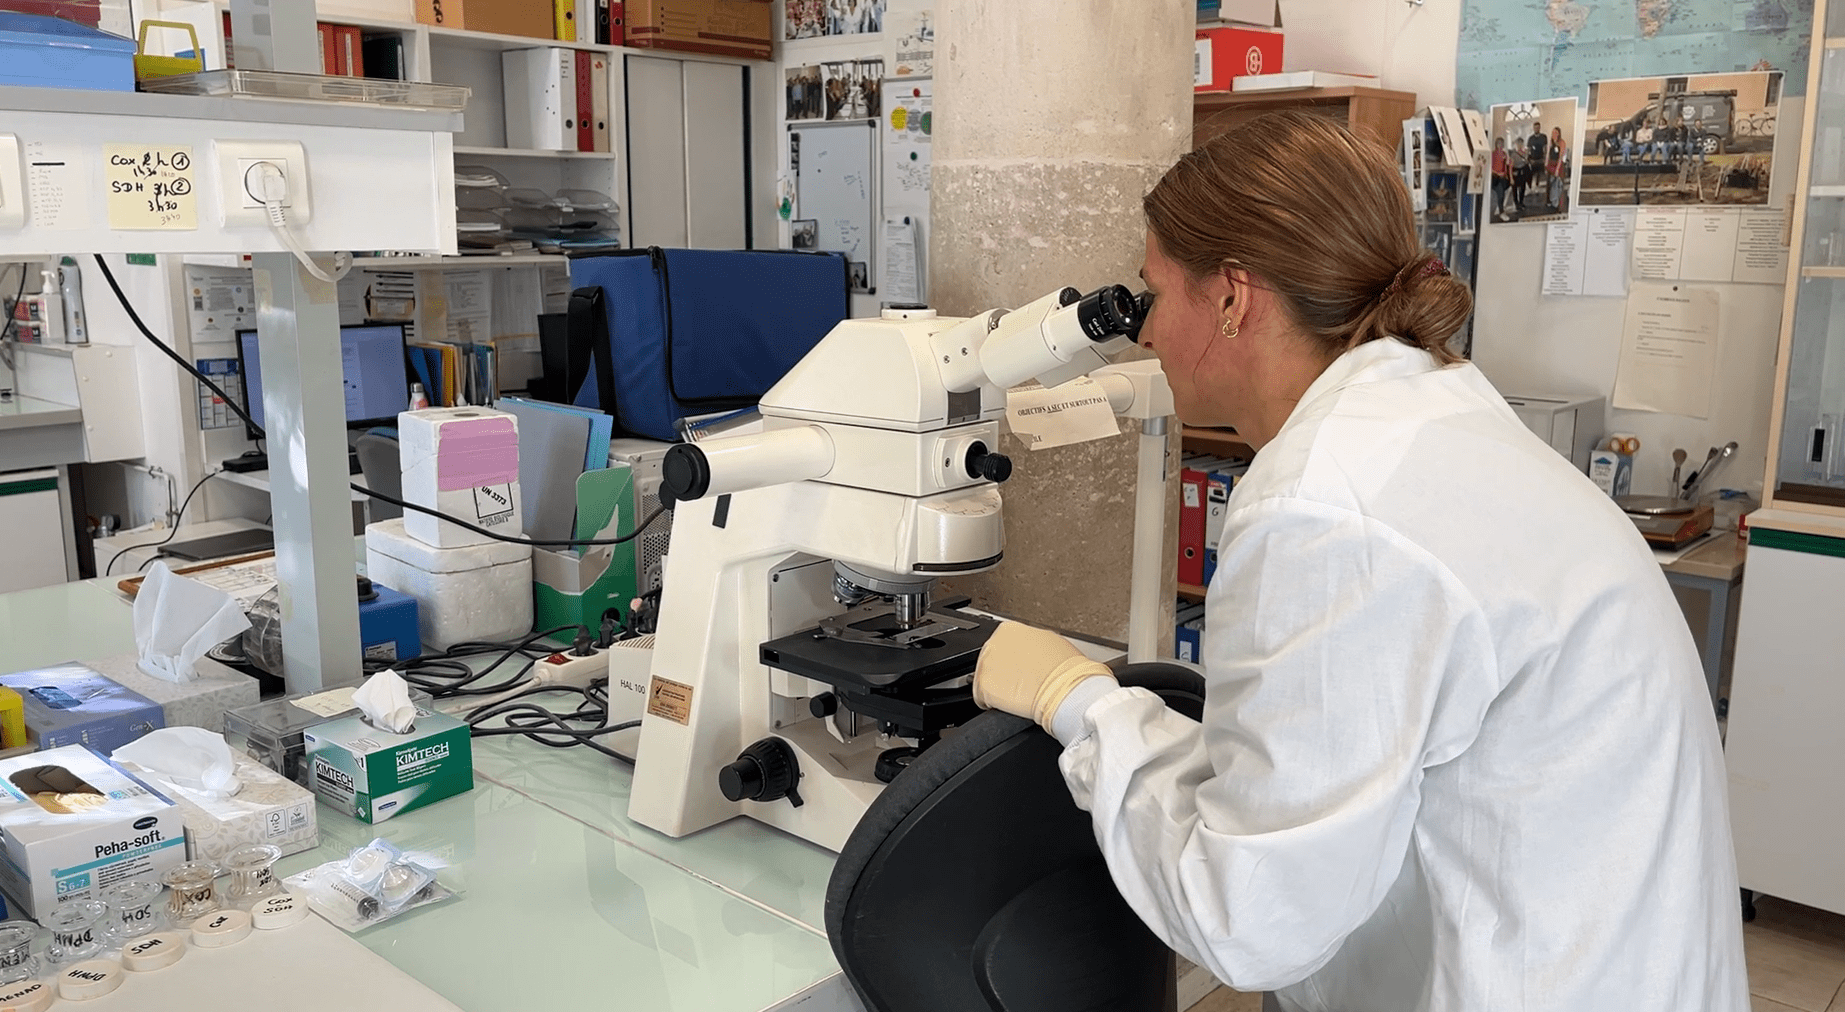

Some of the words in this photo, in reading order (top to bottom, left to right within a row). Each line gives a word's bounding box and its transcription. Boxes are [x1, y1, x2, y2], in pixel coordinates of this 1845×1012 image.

[112, 180, 143, 193] SDH
[1017, 406, 1046, 417] OBJECTIFS
[1070, 399, 1093, 408] SURTOUT
[481, 486, 492, 496] UN
[491, 492, 507, 506] 3373
[620, 679, 633, 691] HAL
[634, 683, 646, 695] 100
[396, 741, 449, 767] KIMTECH
[315, 761, 354, 788] KIMTECH
[94, 829, 161, 859] Peha-soft
[58, 880, 68, 893] S
